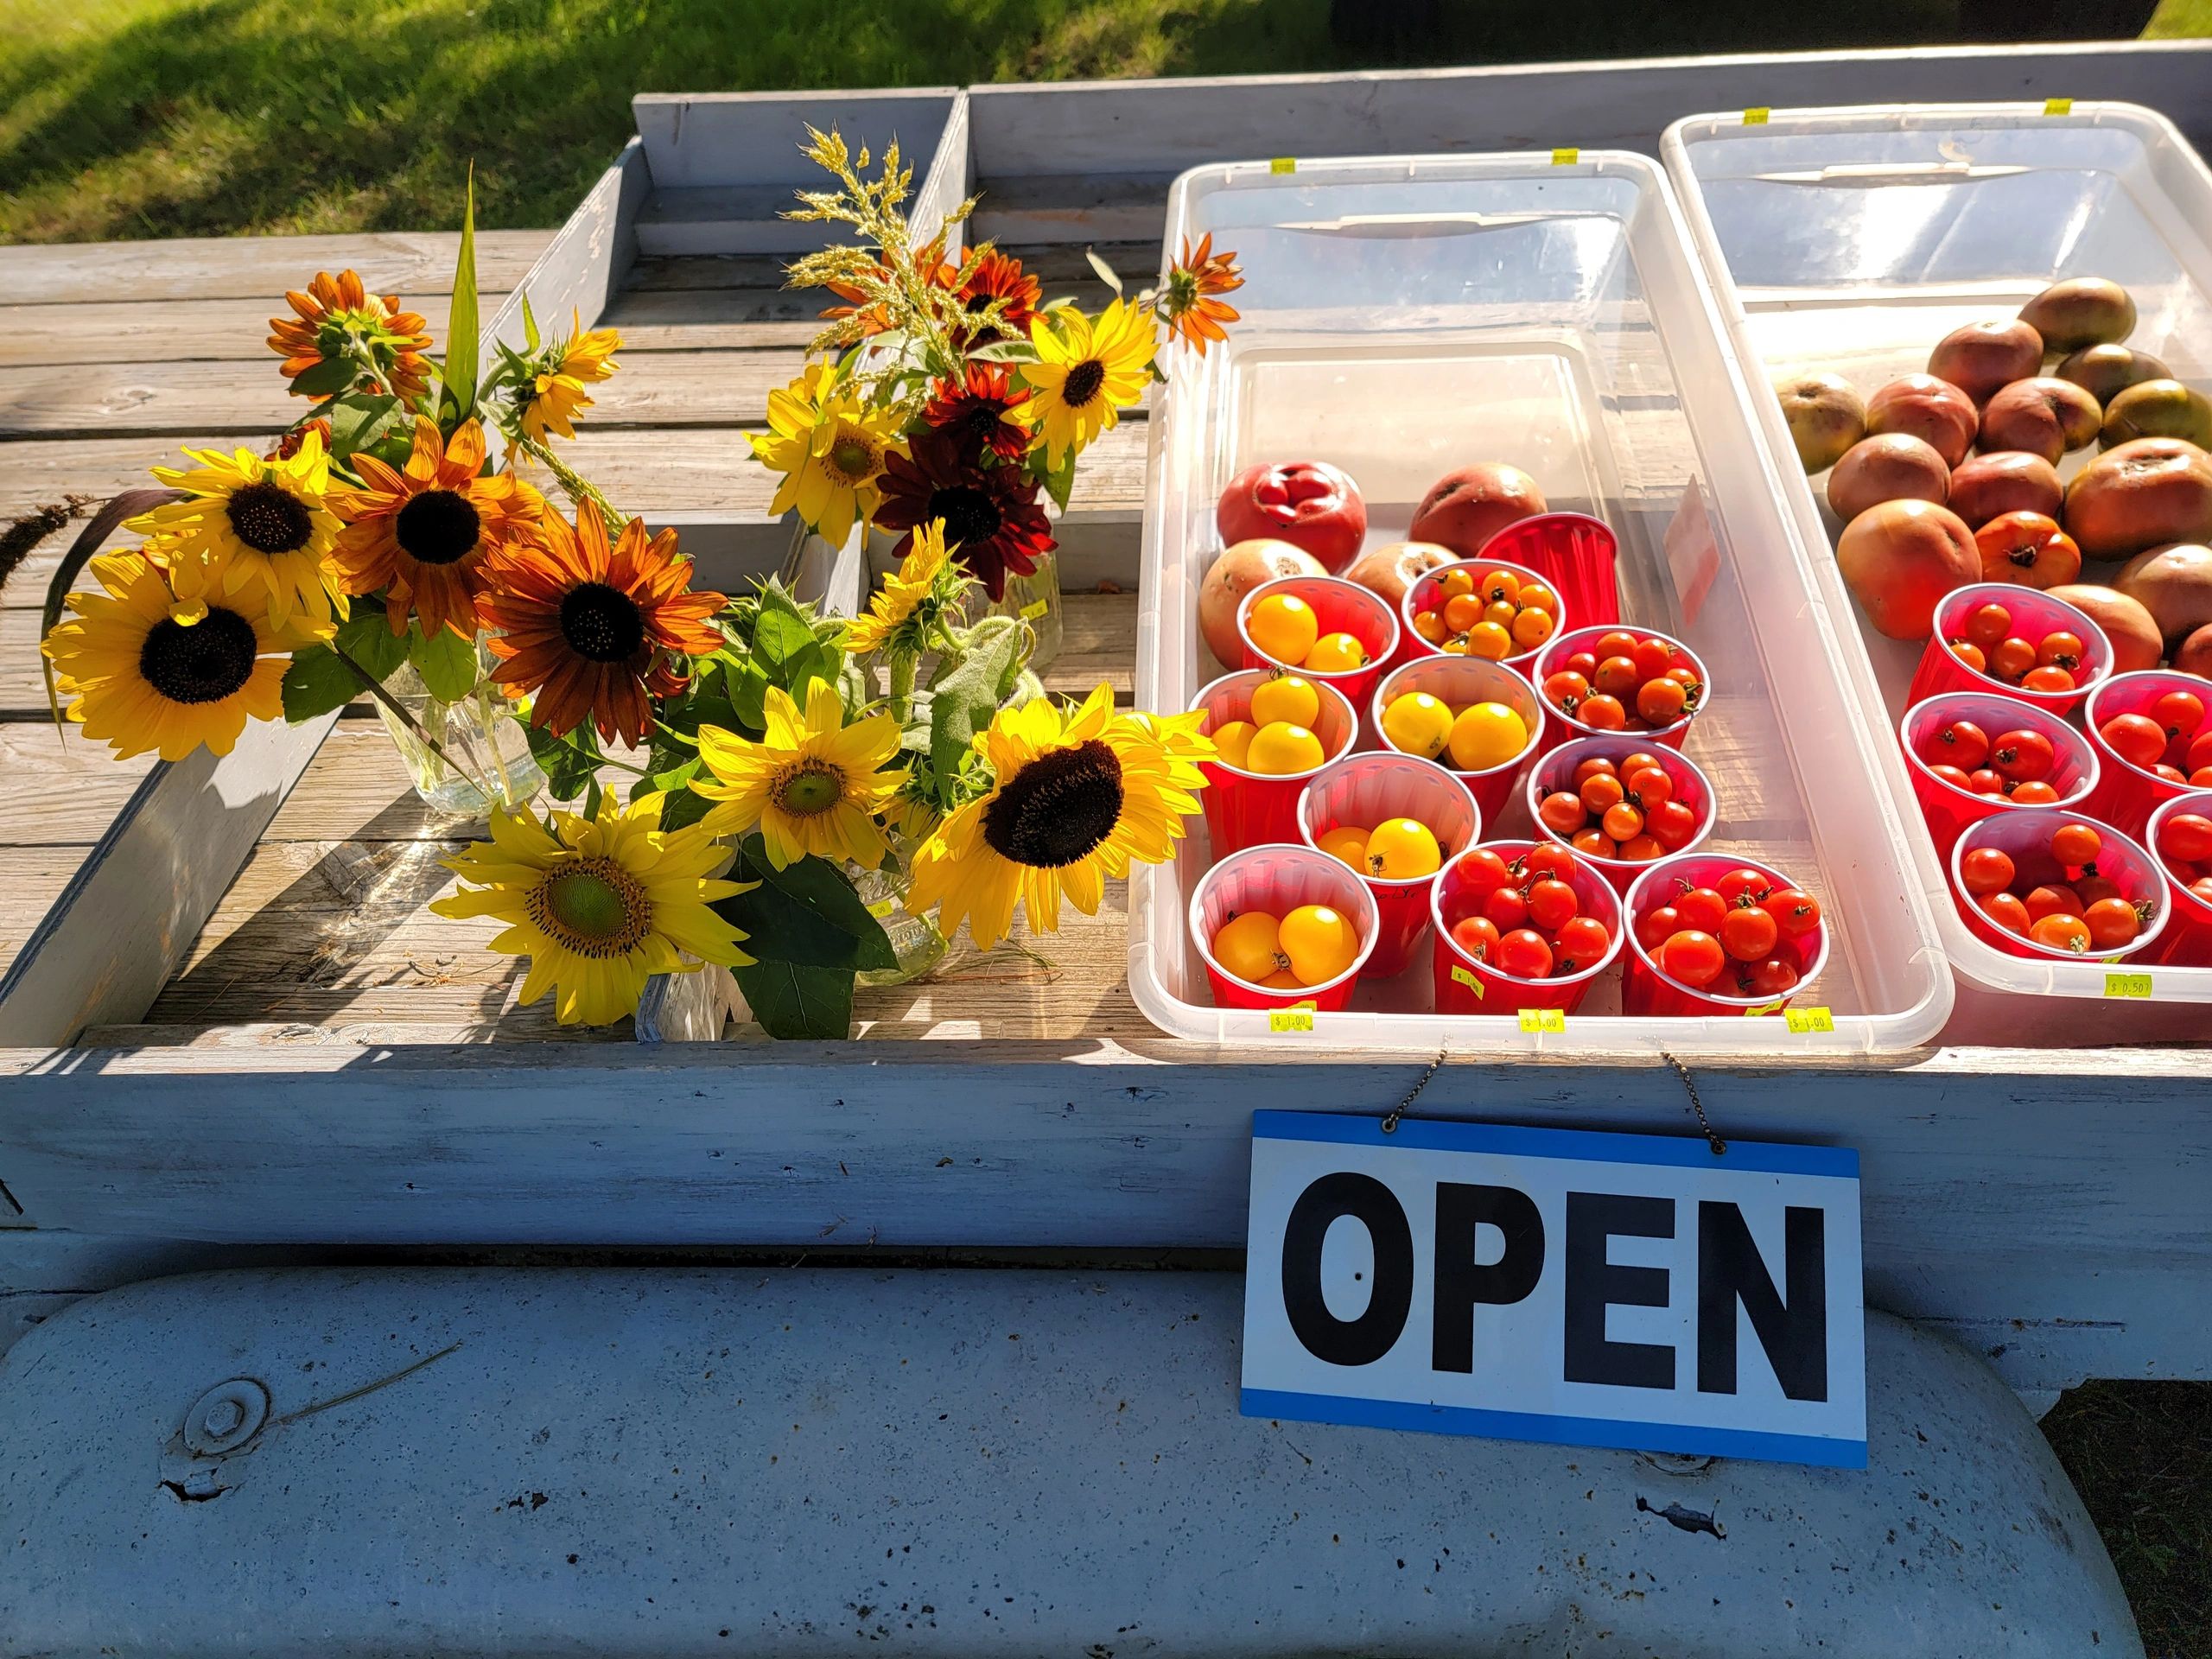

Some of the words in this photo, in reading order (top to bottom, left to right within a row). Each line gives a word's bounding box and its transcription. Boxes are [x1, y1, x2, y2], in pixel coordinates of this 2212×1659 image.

[1287, 1015, 1306, 1026] 1.00
[1537, 1018, 1556, 1027] 1.00
[1805, 1017, 1825, 1028] 1.00
[1281, 1172, 1827, 1402] OPEN
